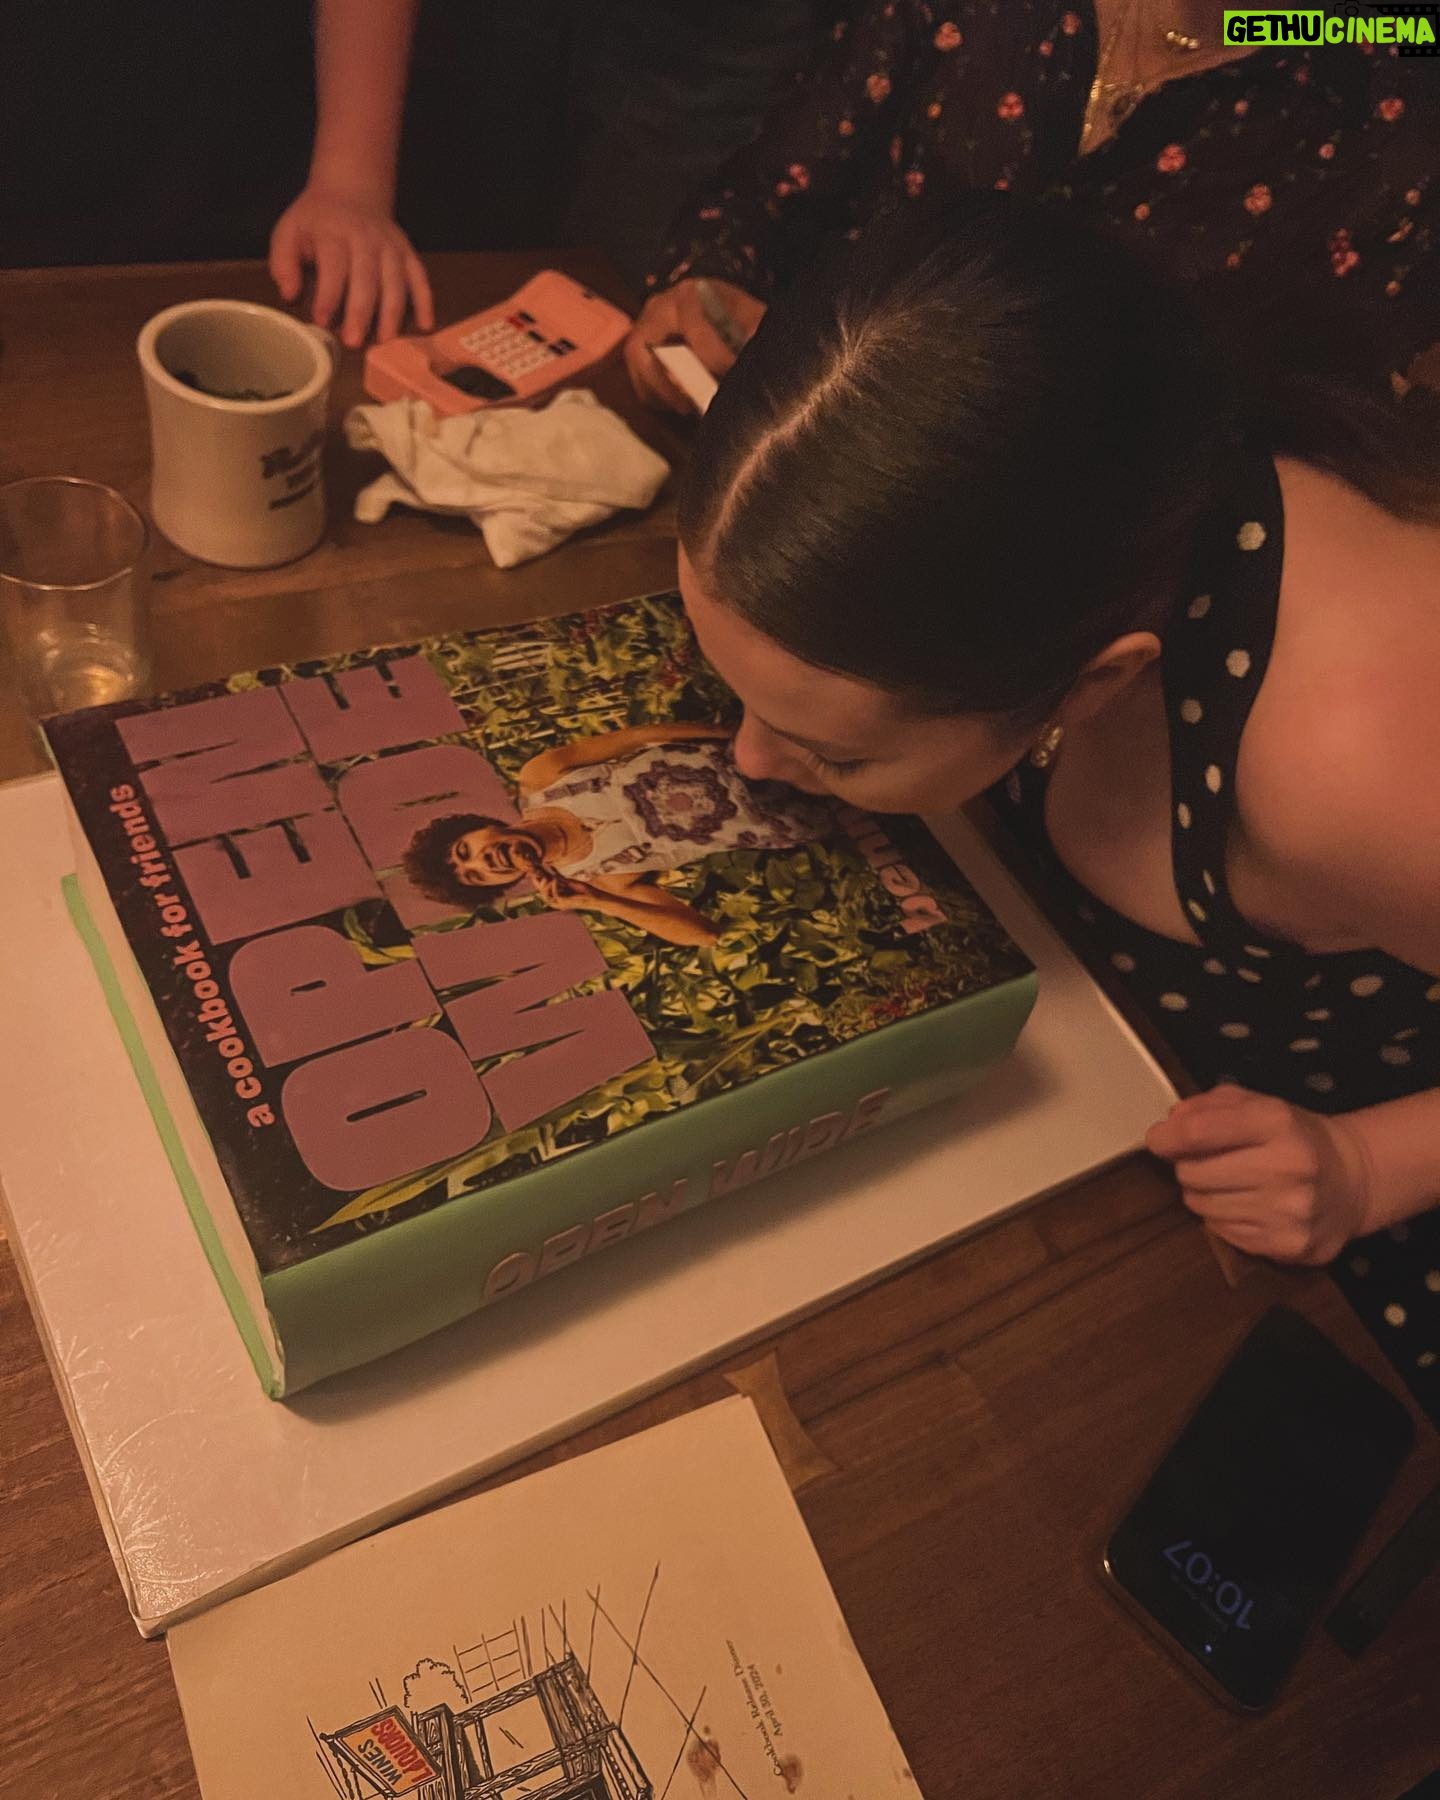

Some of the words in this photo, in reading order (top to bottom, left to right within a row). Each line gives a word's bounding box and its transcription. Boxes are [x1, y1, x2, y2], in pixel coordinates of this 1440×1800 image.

[109, 783, 172, 888] friends
[115, 686, 493, 1192] OPEN
[153, 893, 193, 938] for
[174, 940, 262, 1099] cookbook
[247, 1103, 275, 1129] a
[709, 1087, 892, 1194] WIDE
[481, 1177, 689, 1298] OPEN
[1162, 1540, 1256, 1630] 10:07
[358, 1738, 403, 1786] WINES
